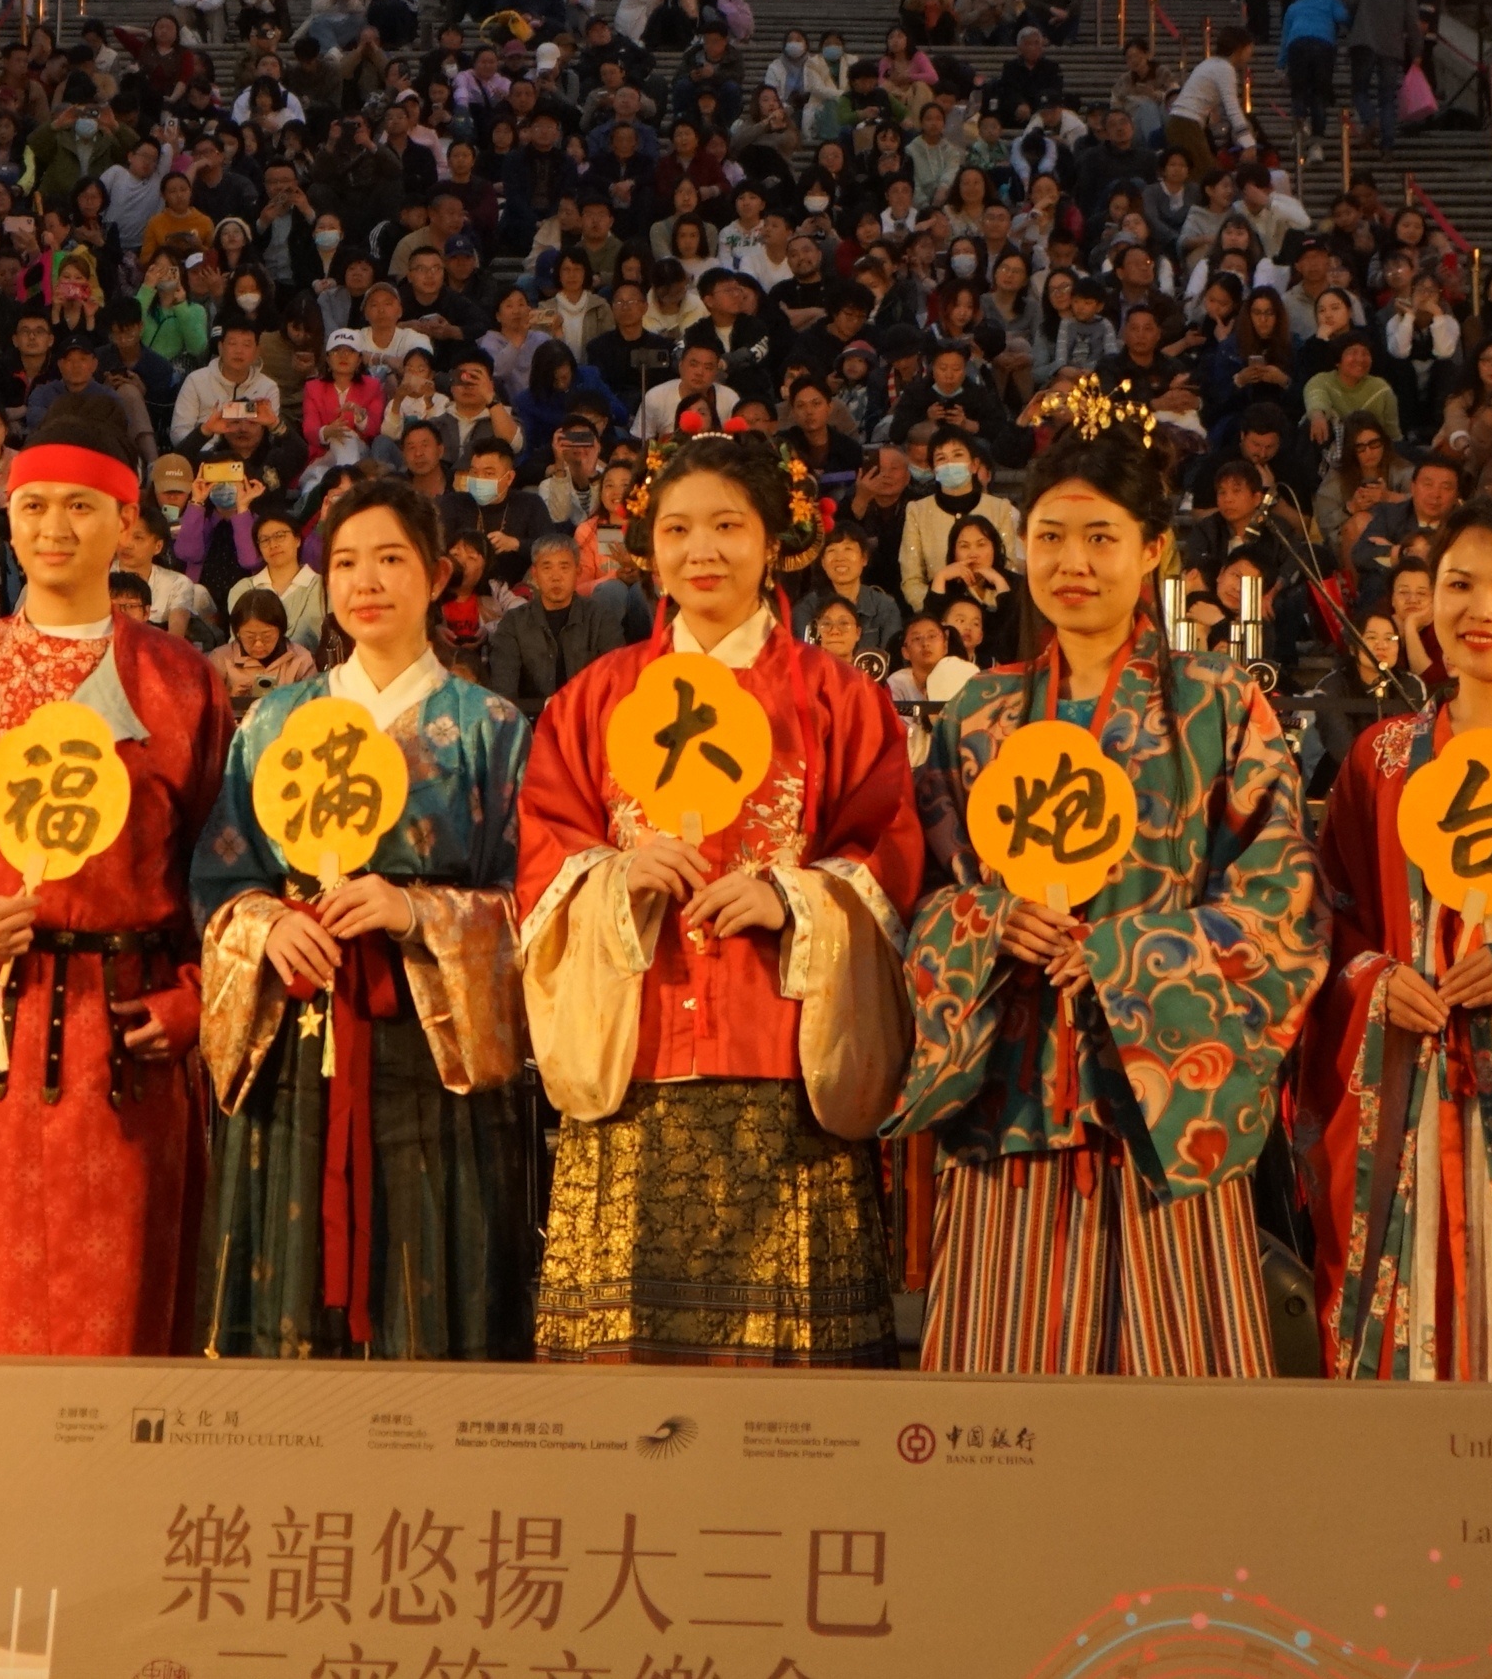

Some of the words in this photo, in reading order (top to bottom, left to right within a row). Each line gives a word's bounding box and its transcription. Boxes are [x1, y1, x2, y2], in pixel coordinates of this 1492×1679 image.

[334, 333, 355, 341] FILA
[654, 676, 744, 791] 大
[4, 738, 104, 856] 福
[281, 722, 383, 844] 滿
[996, 752, 1122, 865] 炮
[169, 1432, 245, 1446] INSTITUTO
[247, 1434, 325, 1448] CULTURAL
[173, 1409, 240, 1428] 文化局
[455, 1437, 489, 1448] Macao
[489, 1438, 537, 1449] Orchestra
[590, 1439, 628, 1451] Limited
[946, 1454, 976, 1465] BANK
[980, 1455, 995, 1465] OF
[997, 1456, 1035, 1466] CHINA
[158, 1502, 894, 1639] 樂韻悠揚大三巴
